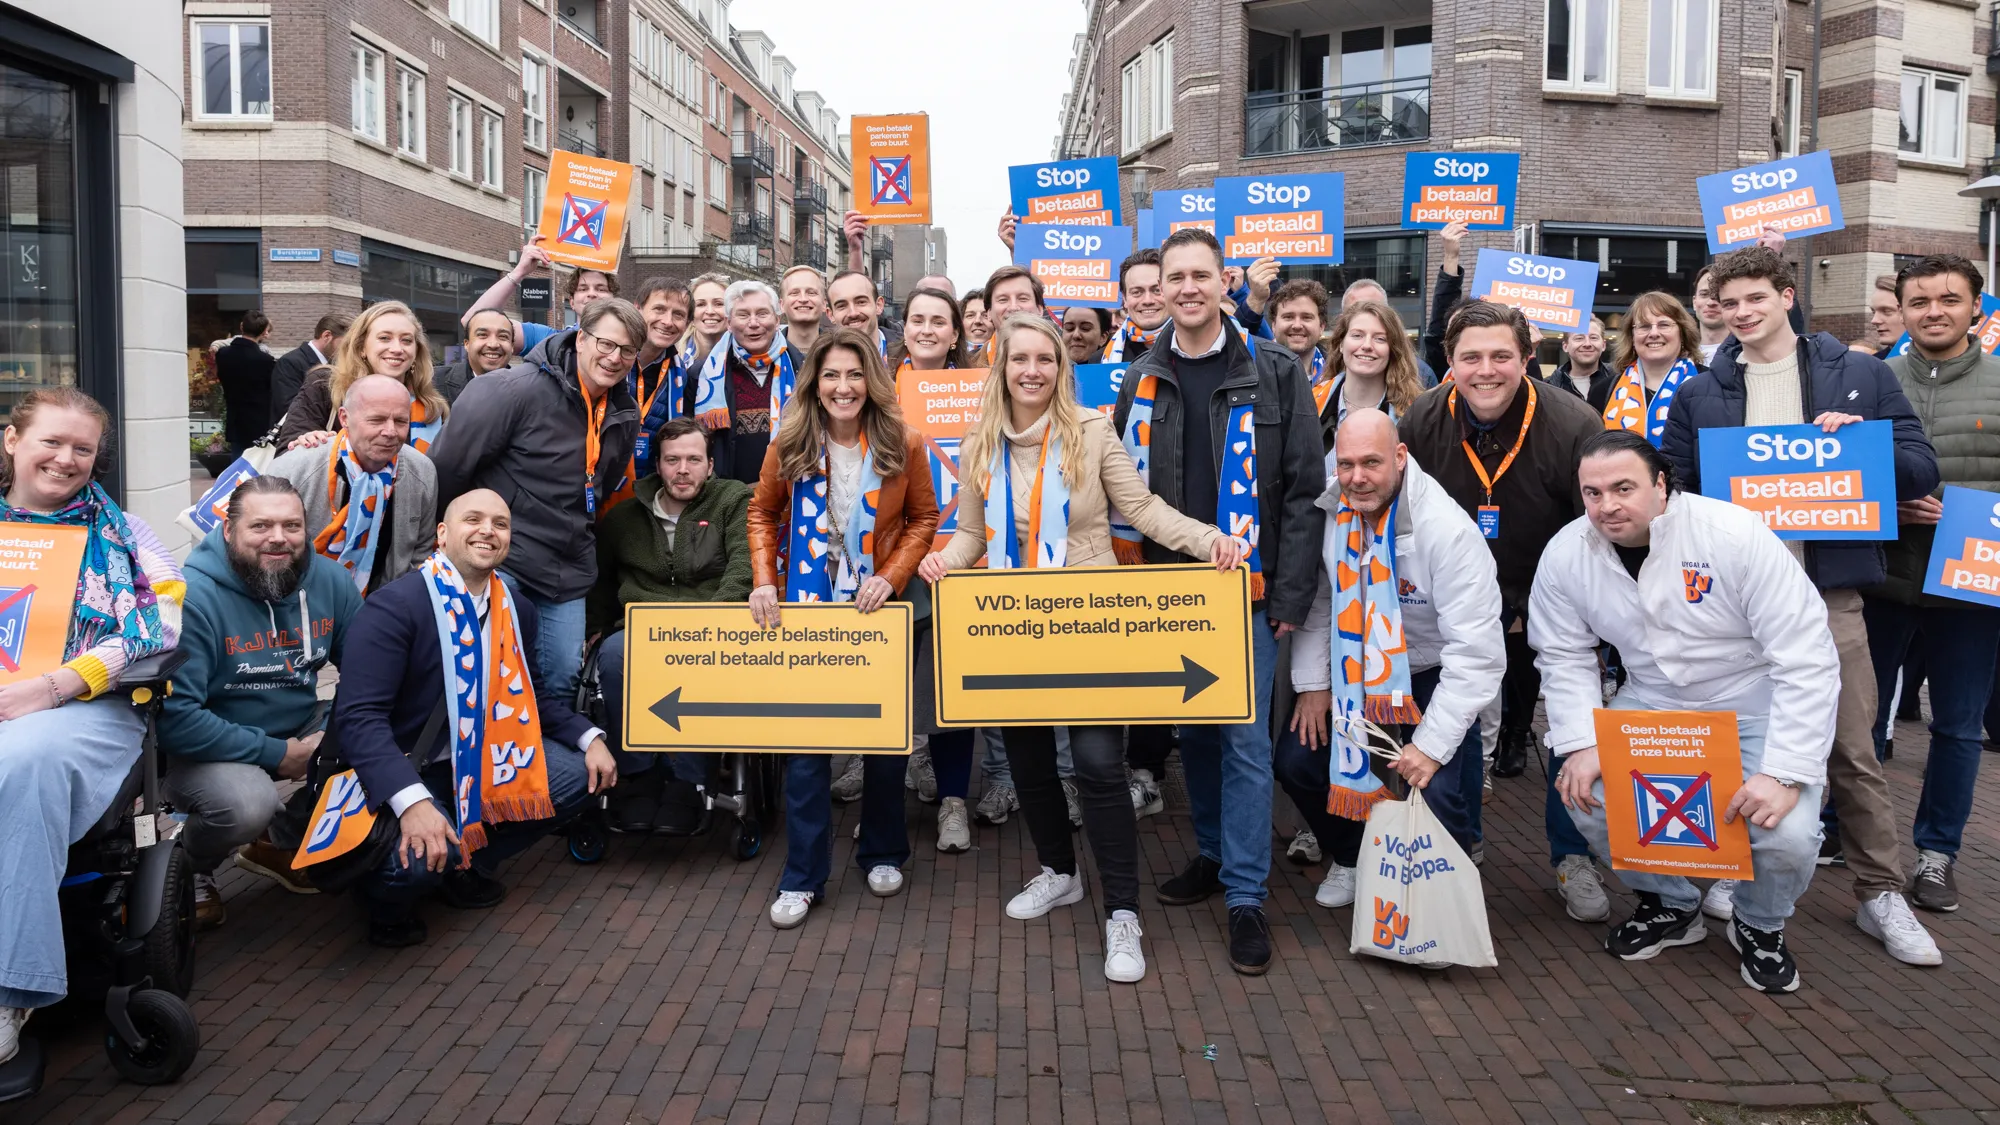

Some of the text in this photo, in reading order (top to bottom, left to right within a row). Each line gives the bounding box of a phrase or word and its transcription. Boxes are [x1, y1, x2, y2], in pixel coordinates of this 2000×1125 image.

[866, 125, 885, 133] Geen
[870, 132, 902, 140] parkeren
[567, 162, 618, 177] Geen betaald
[570, 171, 605, 183] parkeren
[1036, 167, 1090, 189] Stop
[1433, 157, 1490, 182] Stop
[569, 178, 611, 191] onze buurt.
[1731, 167, 1798, 193] Stop
[1034, 193, 1097, 213] betaald
[1180, 193, 1215, 213] Sto
[1247, 182, 1310, 208] Stop
[1427, 187, 1492, 202] betaald
[1416, 206, 1498, 223] parkeren!
[1731, 191, 1809, 220] betaald
[1241, 214, 1316, 233] betaald
[1724, 208, 1823, 244] parkeren!
[1043, 229, 1101, 256] Stop
[1232, 235, 1325, 259] parkeren!
[1037, 261, 1104, 277] betaald
[1506, 257, 1566, 284] Stop
[1042, 281, 1112, 298] arkeren!
[1497, 283, 1568, 304] betaald
[918, 381, 957, 393] Geen
[926, 412, 961, 424] onze
[1746, 433, 1841, 467] Stop
[1741, 475, 1852, 499] betaald
[28, 550, 43, 560] in
[975, 592, 1206, 614] VVD: lagere lasten, geen
[1398, 597, 1428, 605] ARTIJN
[649, 627, 888, 645] Linksaf: hogere belastingen,
[967, 616, 1216, 639] onnodig betaald parkeren.
[236, 662, 285, 674] Premium
[664, 651, 871, 669] overal betaald parkeren.
[1621, 724, 1711, 736] Geen betaald
[1629, 736, 1704, 749] parkeren in
[1630, 748, 1706, 758] onze buurt.
[1379, 857, 1396, 880] in
[1624, 856, 1739, 871] www.geenbetaaldparkeren.nl
[1399, 940, 1437, 956] Europa
